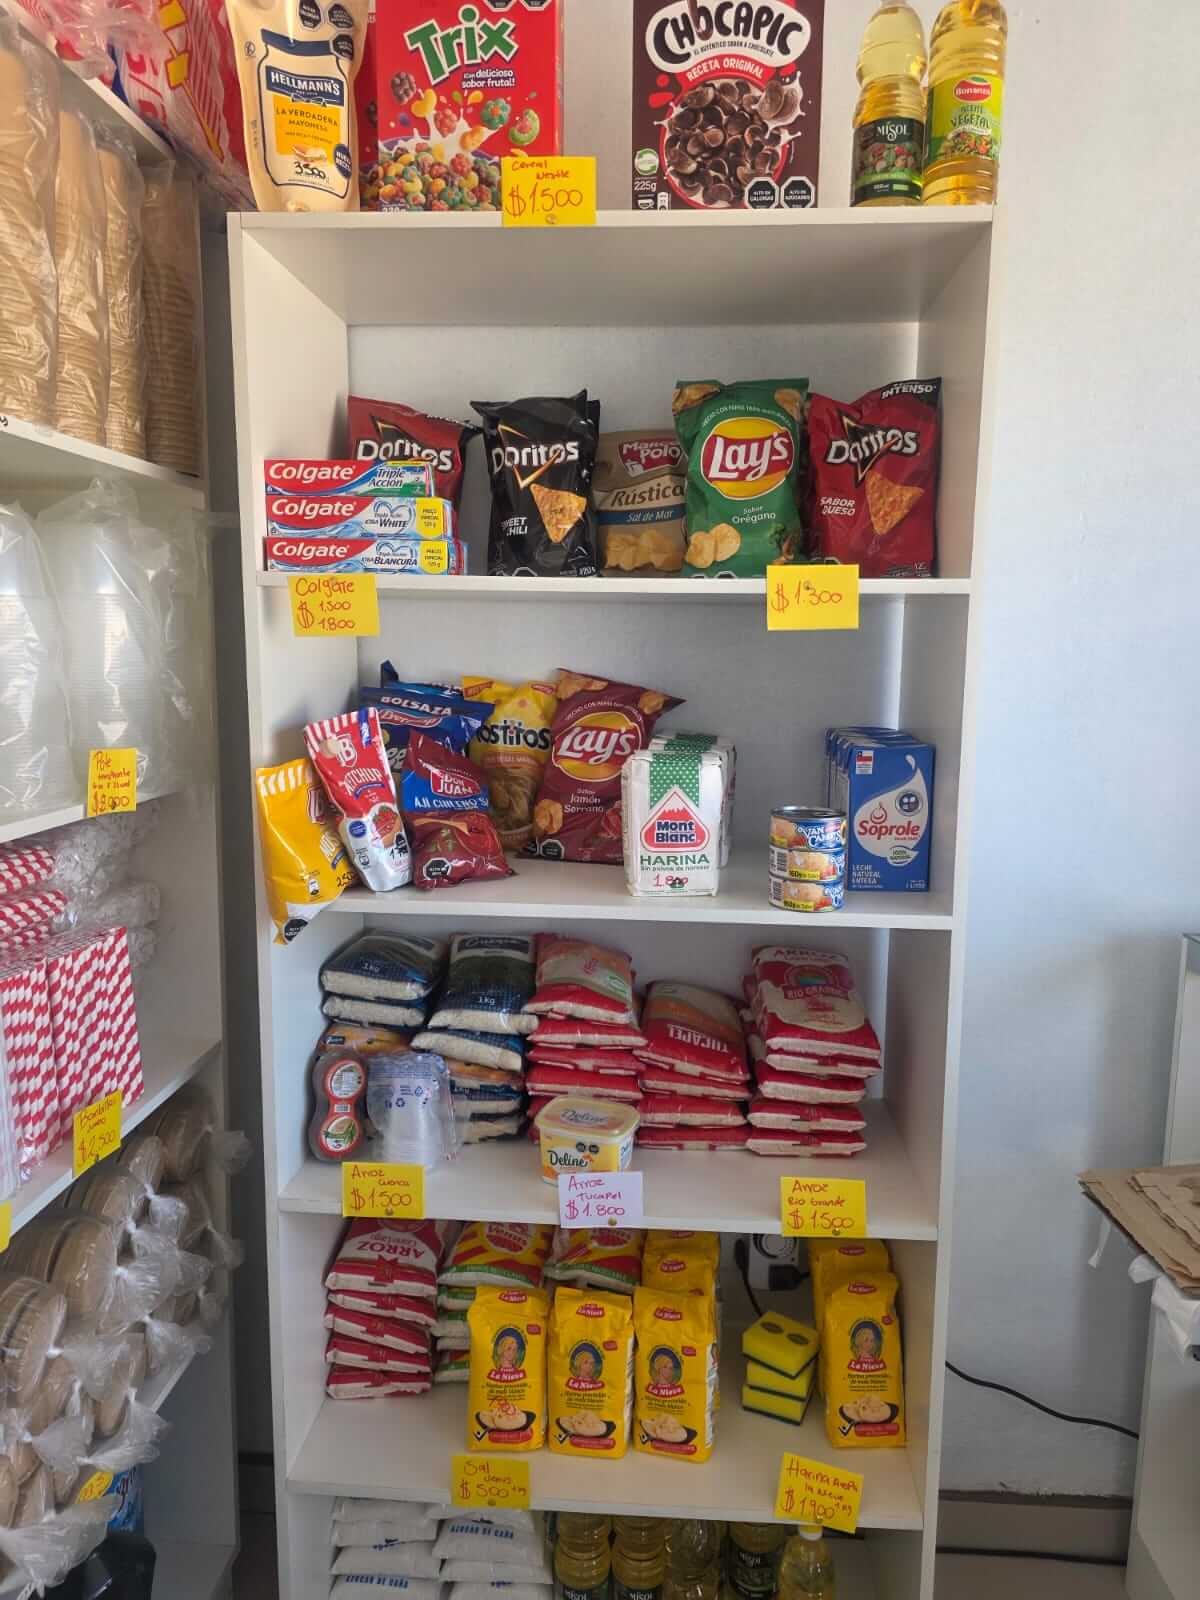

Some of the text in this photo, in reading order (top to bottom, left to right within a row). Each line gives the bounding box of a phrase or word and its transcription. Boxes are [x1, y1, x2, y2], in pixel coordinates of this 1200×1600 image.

[653, 1, 803, 64] CHOCAPIC
[403, 4, 519, 85] Trix
[475, 68, 513, 78] delicioso
[686, 56, 764, 81] RECETA ORIGINAL
[270, 71, 340, 96] HELLMANN'S
[461, 77, 515, 88] sabor frutal!
[275, 106, 338, 127] LA VERDADERA
[511, 159, 548, 171] Cereal
[881, 384, 933, 400] INTENSO
[356, 439, 452, 472] Doritos
[640, 445, 682, 465] Polo
[826, 428, 919, 465] Doritos
[491, 441, 579, 475] Doritos
[707, 431, 790, 482] Lay's
[269, 462, 356, 484] Colgate
[376, 468, 405, 479] Triple
[271, 498, 357, 518] Colgate
[820, 497, 856, 508] SABOR
[379, 519, 408, 528] WHITE
[271, 541, 350, 561] Colgate
[374, 557, 418, 567] BLANCURA
[295, 577, 355, 598] Colgate
[381, 696, 452, 716] BOLSAZA
[556, 727, 636, 766] Lay's
[437, 779, 473, 795] JUAN
[656, 821, 695, 832] Mont
[858, 820, 921, 841] Soprole
[655, 832, 696, 843] Blanc
[640, 853, 711, 867] HARINA
[547, 1149, 589, 1168] Deline
[351, 1164, 385, 1179] Arroz
[568, 1175, 605, 1192] Arroz
[791, 1179, 829, 1193] Arroz
[356, 1241, 425, 1260] ARROZ
[463, 1460, 490, 1476] Sal
